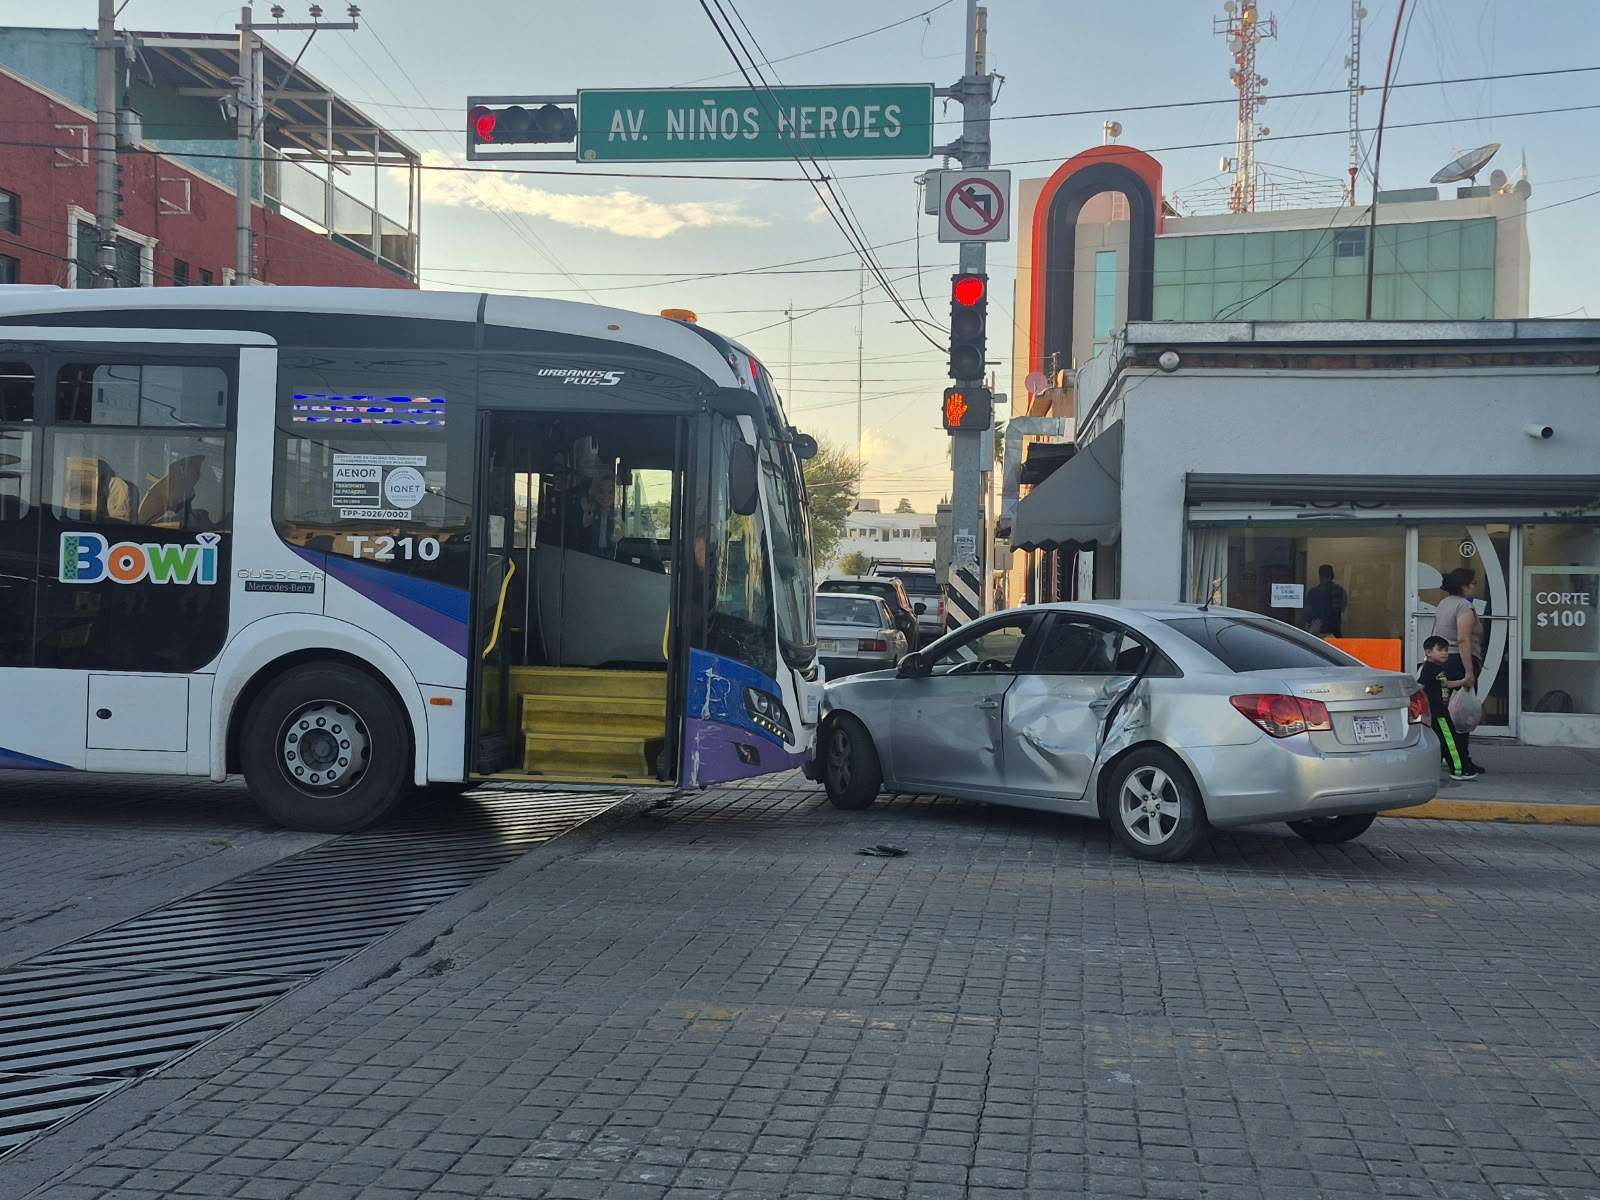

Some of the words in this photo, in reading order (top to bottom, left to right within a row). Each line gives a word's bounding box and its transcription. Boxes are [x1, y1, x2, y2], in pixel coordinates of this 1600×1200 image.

[609, 109, 649, 143] AV.
[665, 100, 761, 141] NIÑOS
[778, 104, 903, 139] HEROES
[537, 368, 606, 378] URBANUS
[563, 378, 602, 386] PLUS
[336, 469, 376, 478] AENOR
[390, 485, 420, 493] IQNET
[342, 510, 409, 519] TPP-2026/0002
[350, 536, 439, 561] T-210
[247, 582, 314, 593] Mercedes-Benz
[1536, 592, 1590, 605] CORTE
[1537, 610, 1586, 627] $100
